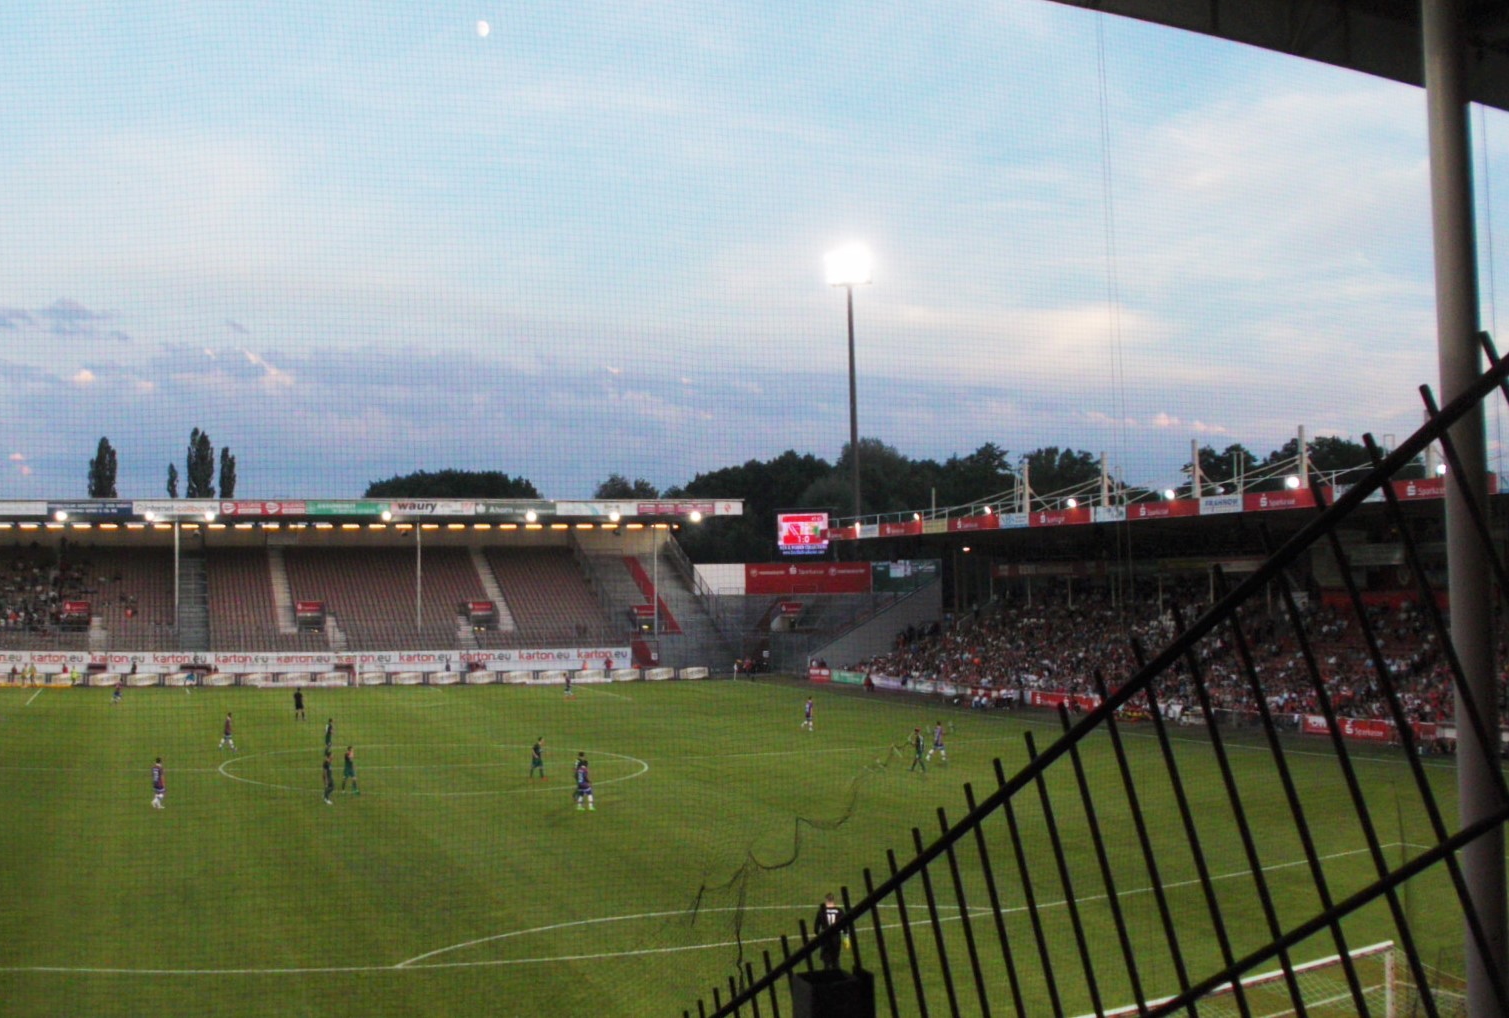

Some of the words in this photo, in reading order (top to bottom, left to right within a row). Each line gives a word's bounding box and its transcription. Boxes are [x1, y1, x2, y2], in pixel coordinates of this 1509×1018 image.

[397, 500, 437, 514] waury
[30, 652, 84, 664] karton.eu
[153, 653, 207, 664] karton.eu
[398, 652, 452, 663] karton.eu
[518, 650, 570, 661] karton.eu
[577, 648, 628, 660] karton.eu
[1354, 727, 1384, 737] Sparkasse
